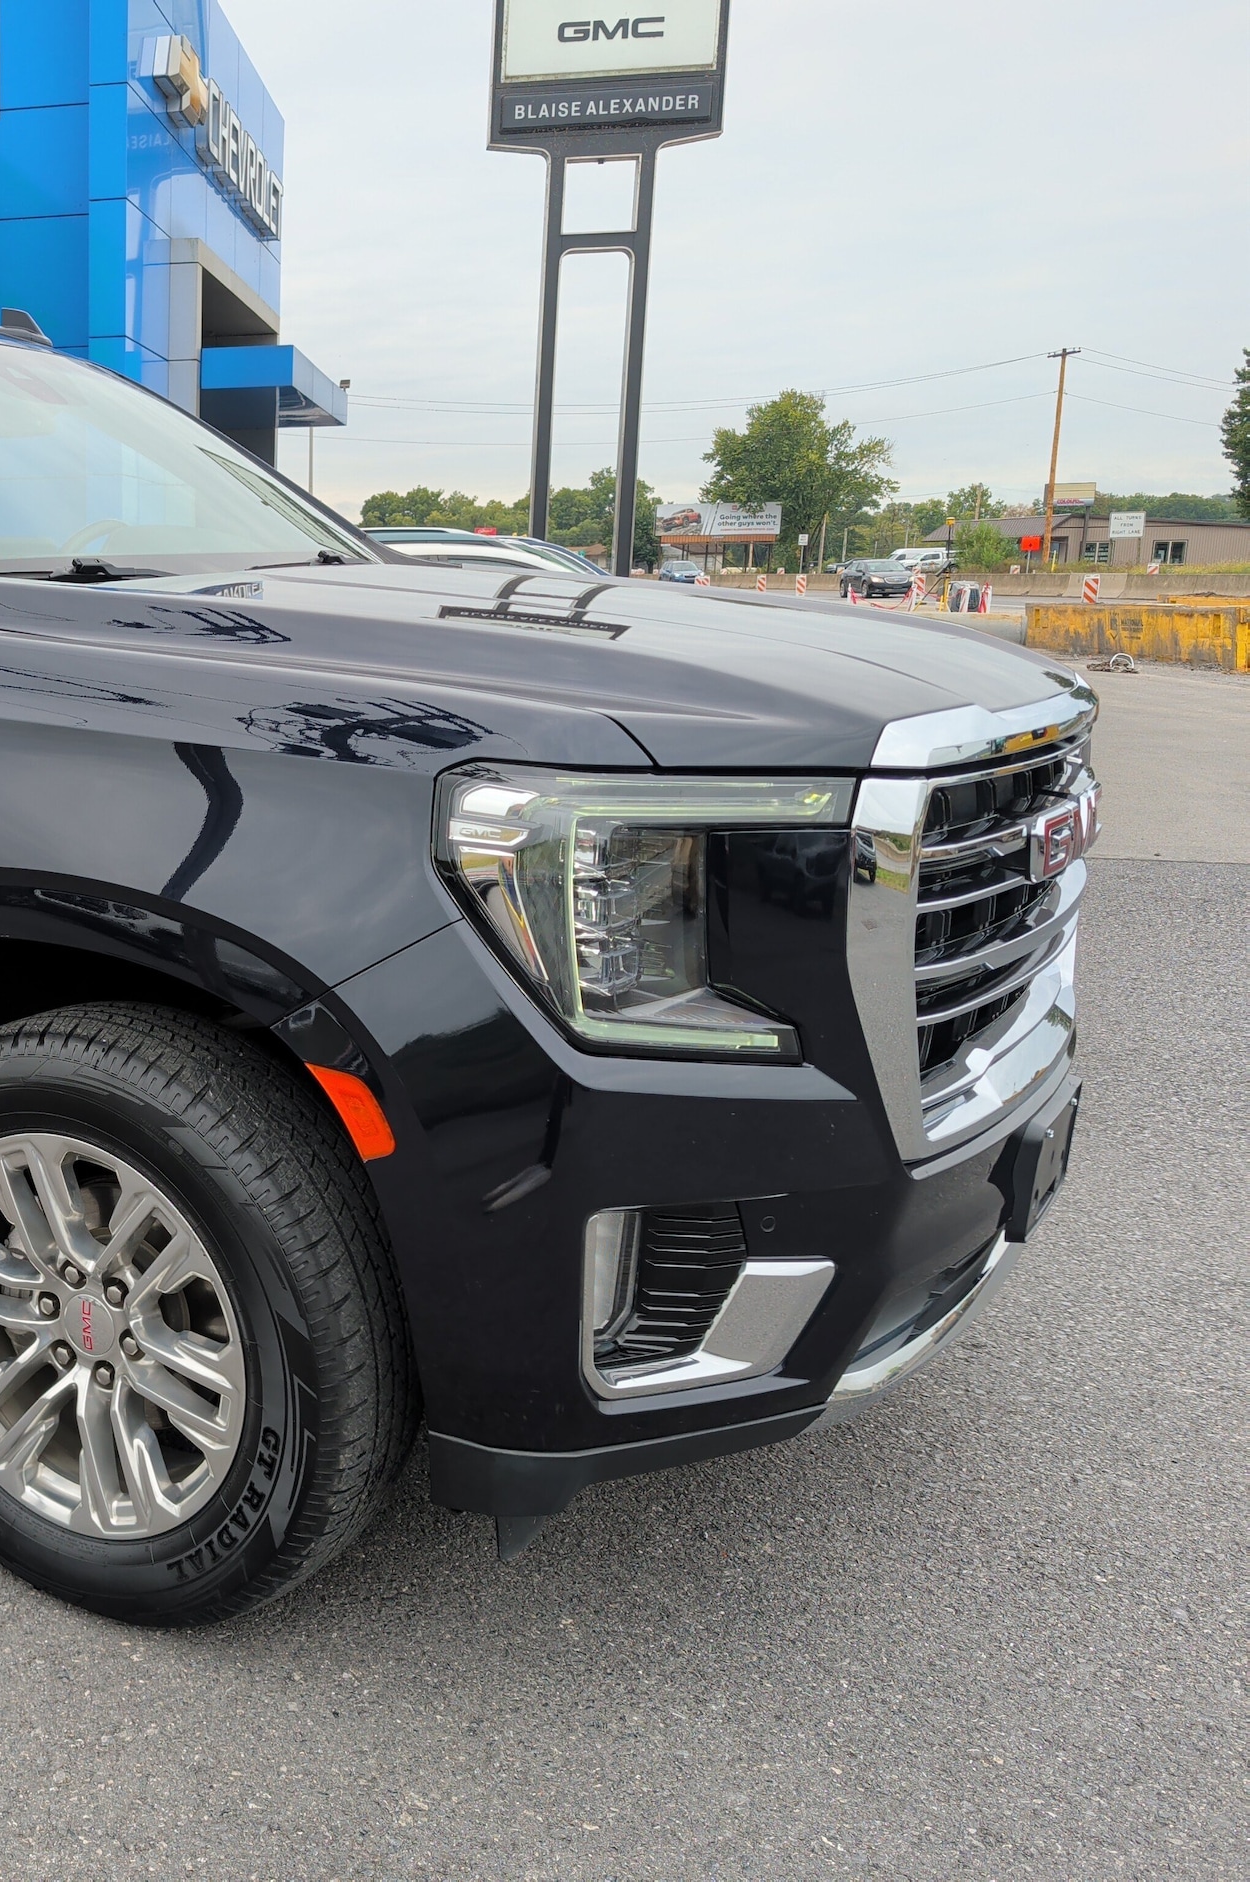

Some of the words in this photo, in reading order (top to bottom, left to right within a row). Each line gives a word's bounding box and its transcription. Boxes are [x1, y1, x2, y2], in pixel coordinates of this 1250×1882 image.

[557, 16, 665, 43] GMC
[514, 101, 581, 120] BLAISE
[586, 94, 699, 116] ALEXANDER
[208, 77, 284, 241] CHEVROLET
[459, 827, 502, 839] GMC
[82, 1300, 93, 1350] GMC
[257, 1426, 281, 1481] GT
[167, 1481, 266, 1581] RADIAL
